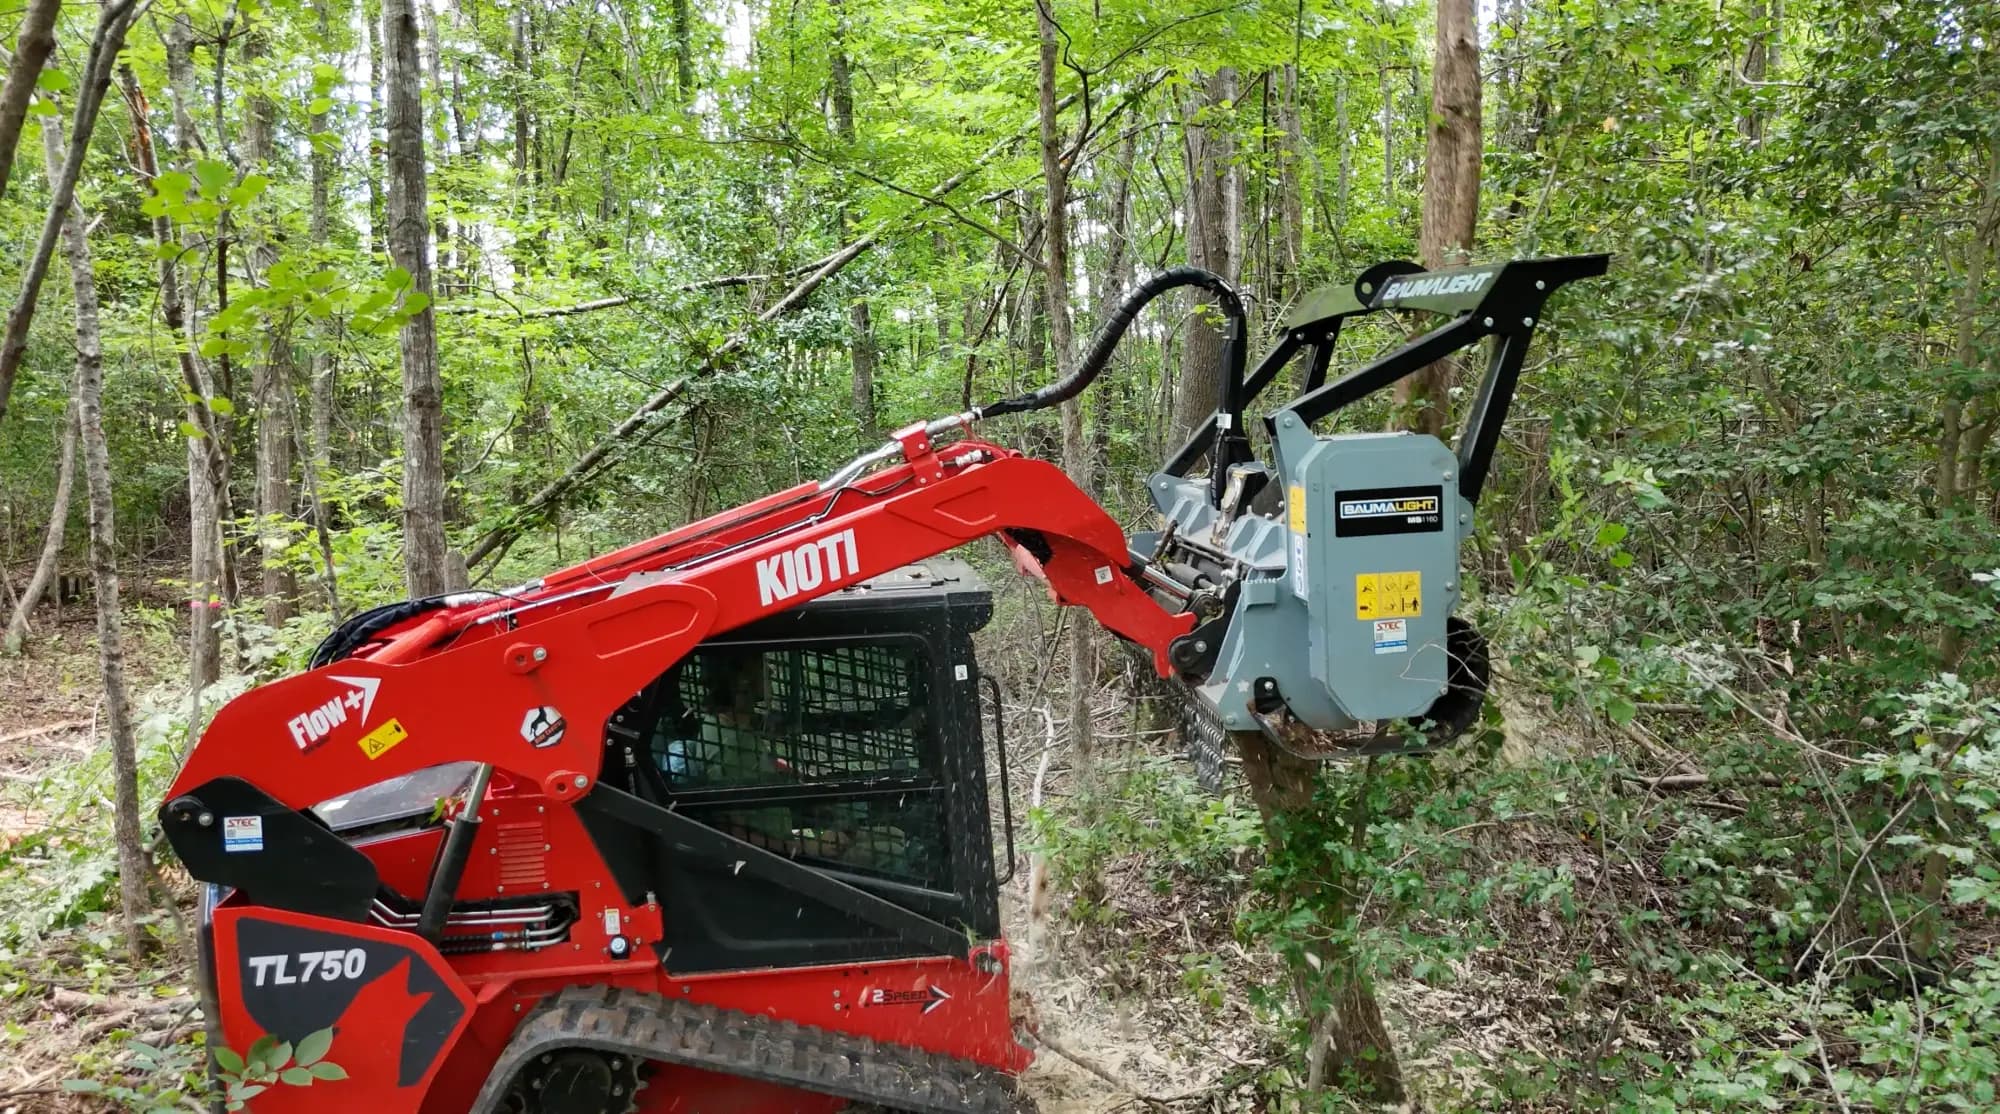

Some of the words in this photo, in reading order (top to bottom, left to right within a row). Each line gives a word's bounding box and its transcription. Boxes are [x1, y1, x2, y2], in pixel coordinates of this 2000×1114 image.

[1382, 271, 1494, 300] BAUMALIGHT
[1343, 499, 1435, 516] BAUMALIGHT
[756, 528, 860, 607] KIOTI
[1376, 620, 1404, 631] STEC
[226, 818, 257, 827] STEC
[248, 947, 367, 987] TL750
